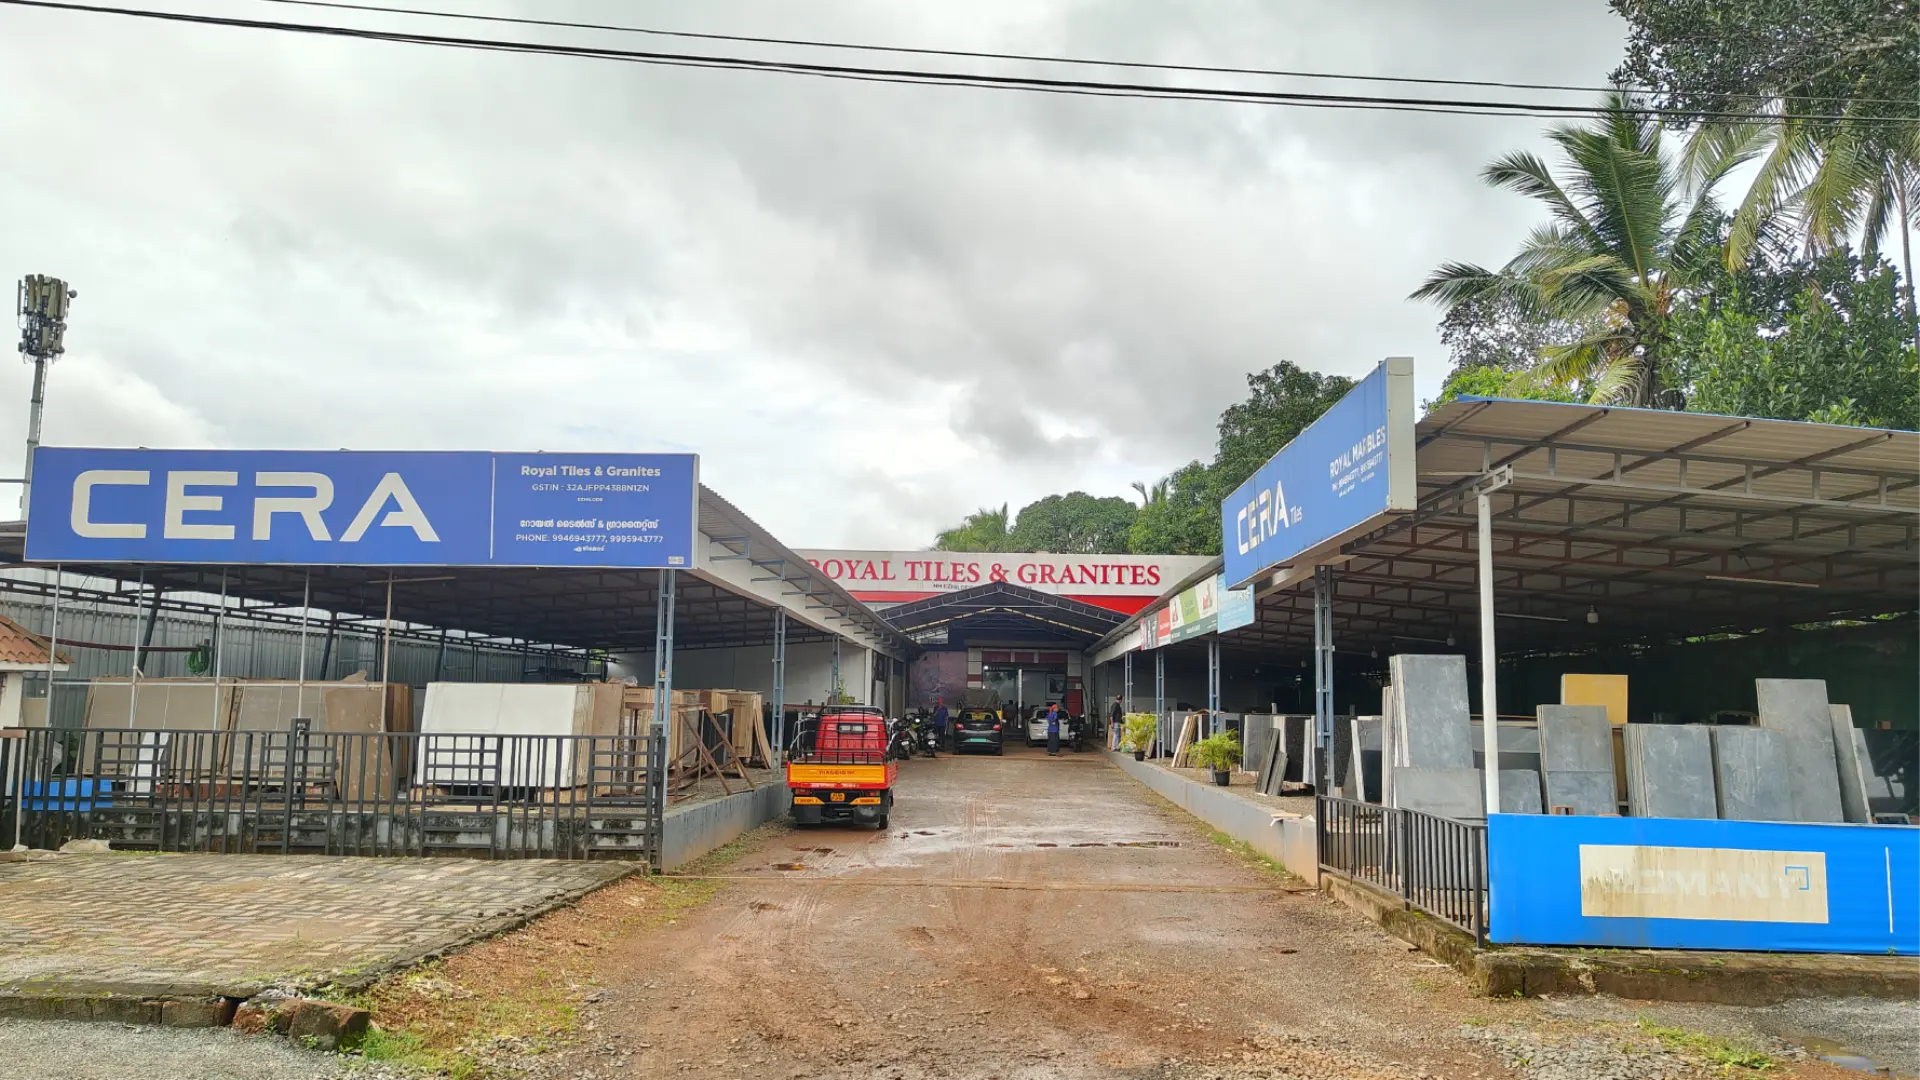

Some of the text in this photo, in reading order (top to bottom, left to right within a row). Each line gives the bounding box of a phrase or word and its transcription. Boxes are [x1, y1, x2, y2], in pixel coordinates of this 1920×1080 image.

[521, 465, 661, 478] Royal Tiles & Granites
[532, 483, 559, 491] GSTIN
[71, 470, 441, 542] CERA
[1237, 480, 1290, 556] CERA
[515, 534, 550, 542] PHONE:
[904, 560, 981, 583] TILES
[988, 562, 1010, 583] &
[1017, 563, 1161, 586] GRANITES
